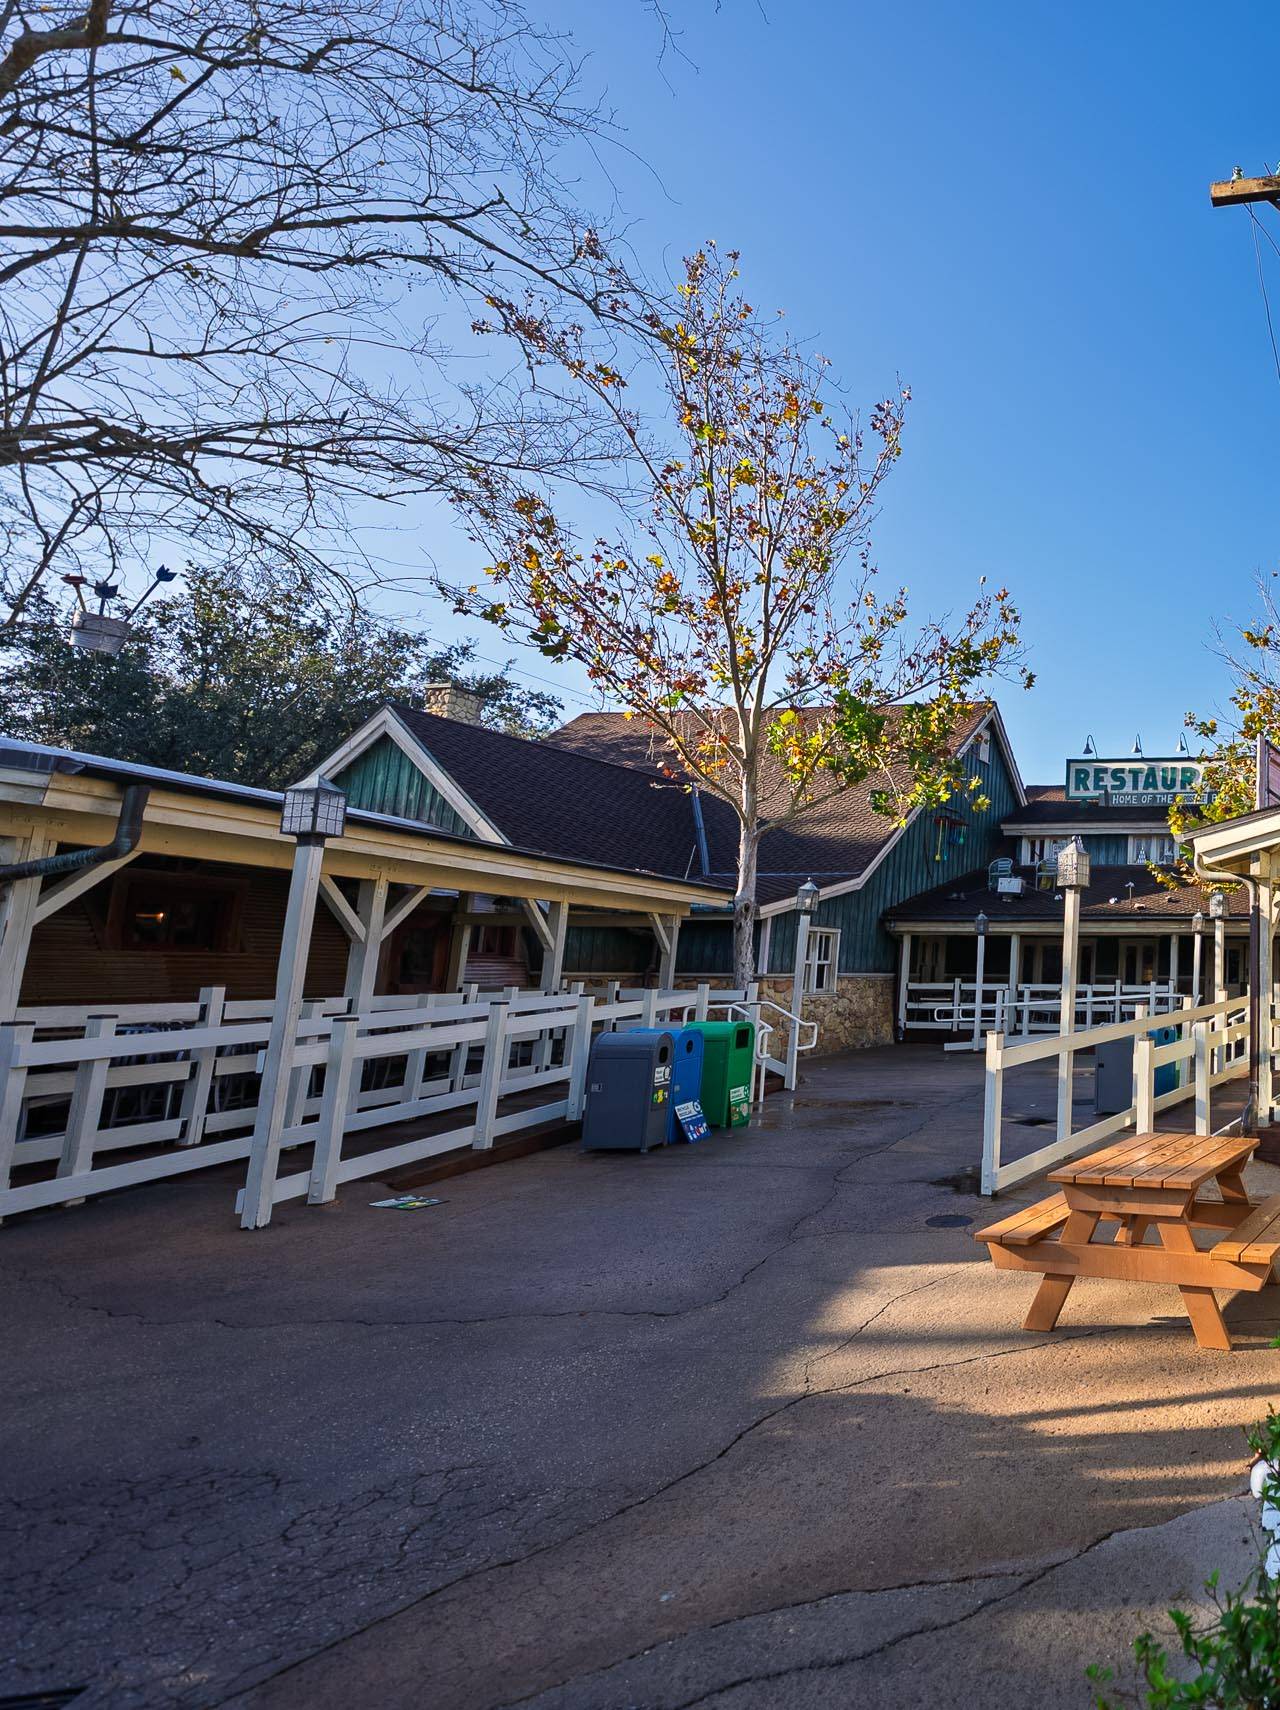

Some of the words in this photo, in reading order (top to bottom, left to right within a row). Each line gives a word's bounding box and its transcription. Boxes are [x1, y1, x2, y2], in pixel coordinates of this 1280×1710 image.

[1074, 767, 1218, 791] RESTAUR
[1112, 794, 1138, 805] HOME
[1141, 795, 1153, 804] OF
[1155, 794, 1174, 804] THE
